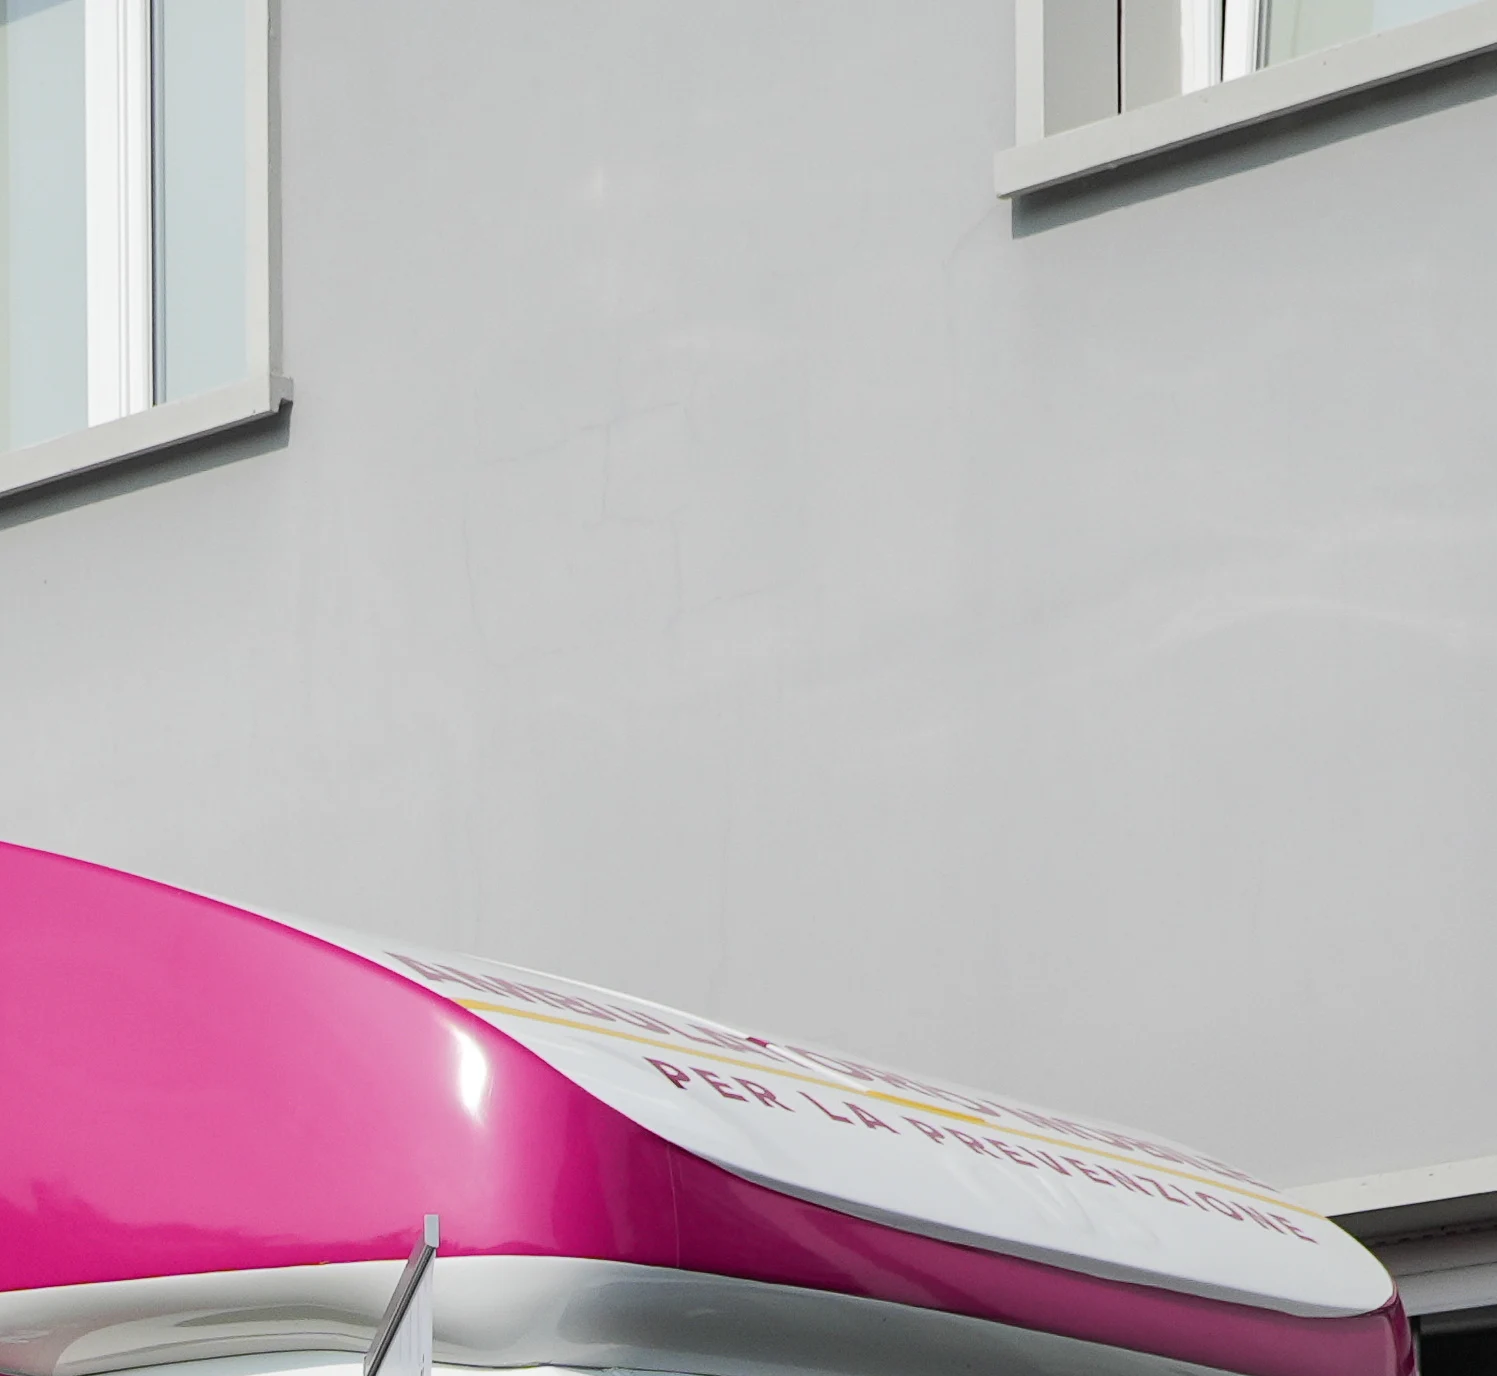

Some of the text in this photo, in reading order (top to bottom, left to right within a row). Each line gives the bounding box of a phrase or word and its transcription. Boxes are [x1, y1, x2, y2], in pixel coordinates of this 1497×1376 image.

[643, 1056, 1318, 1245] PER LA PREVENZIONE
